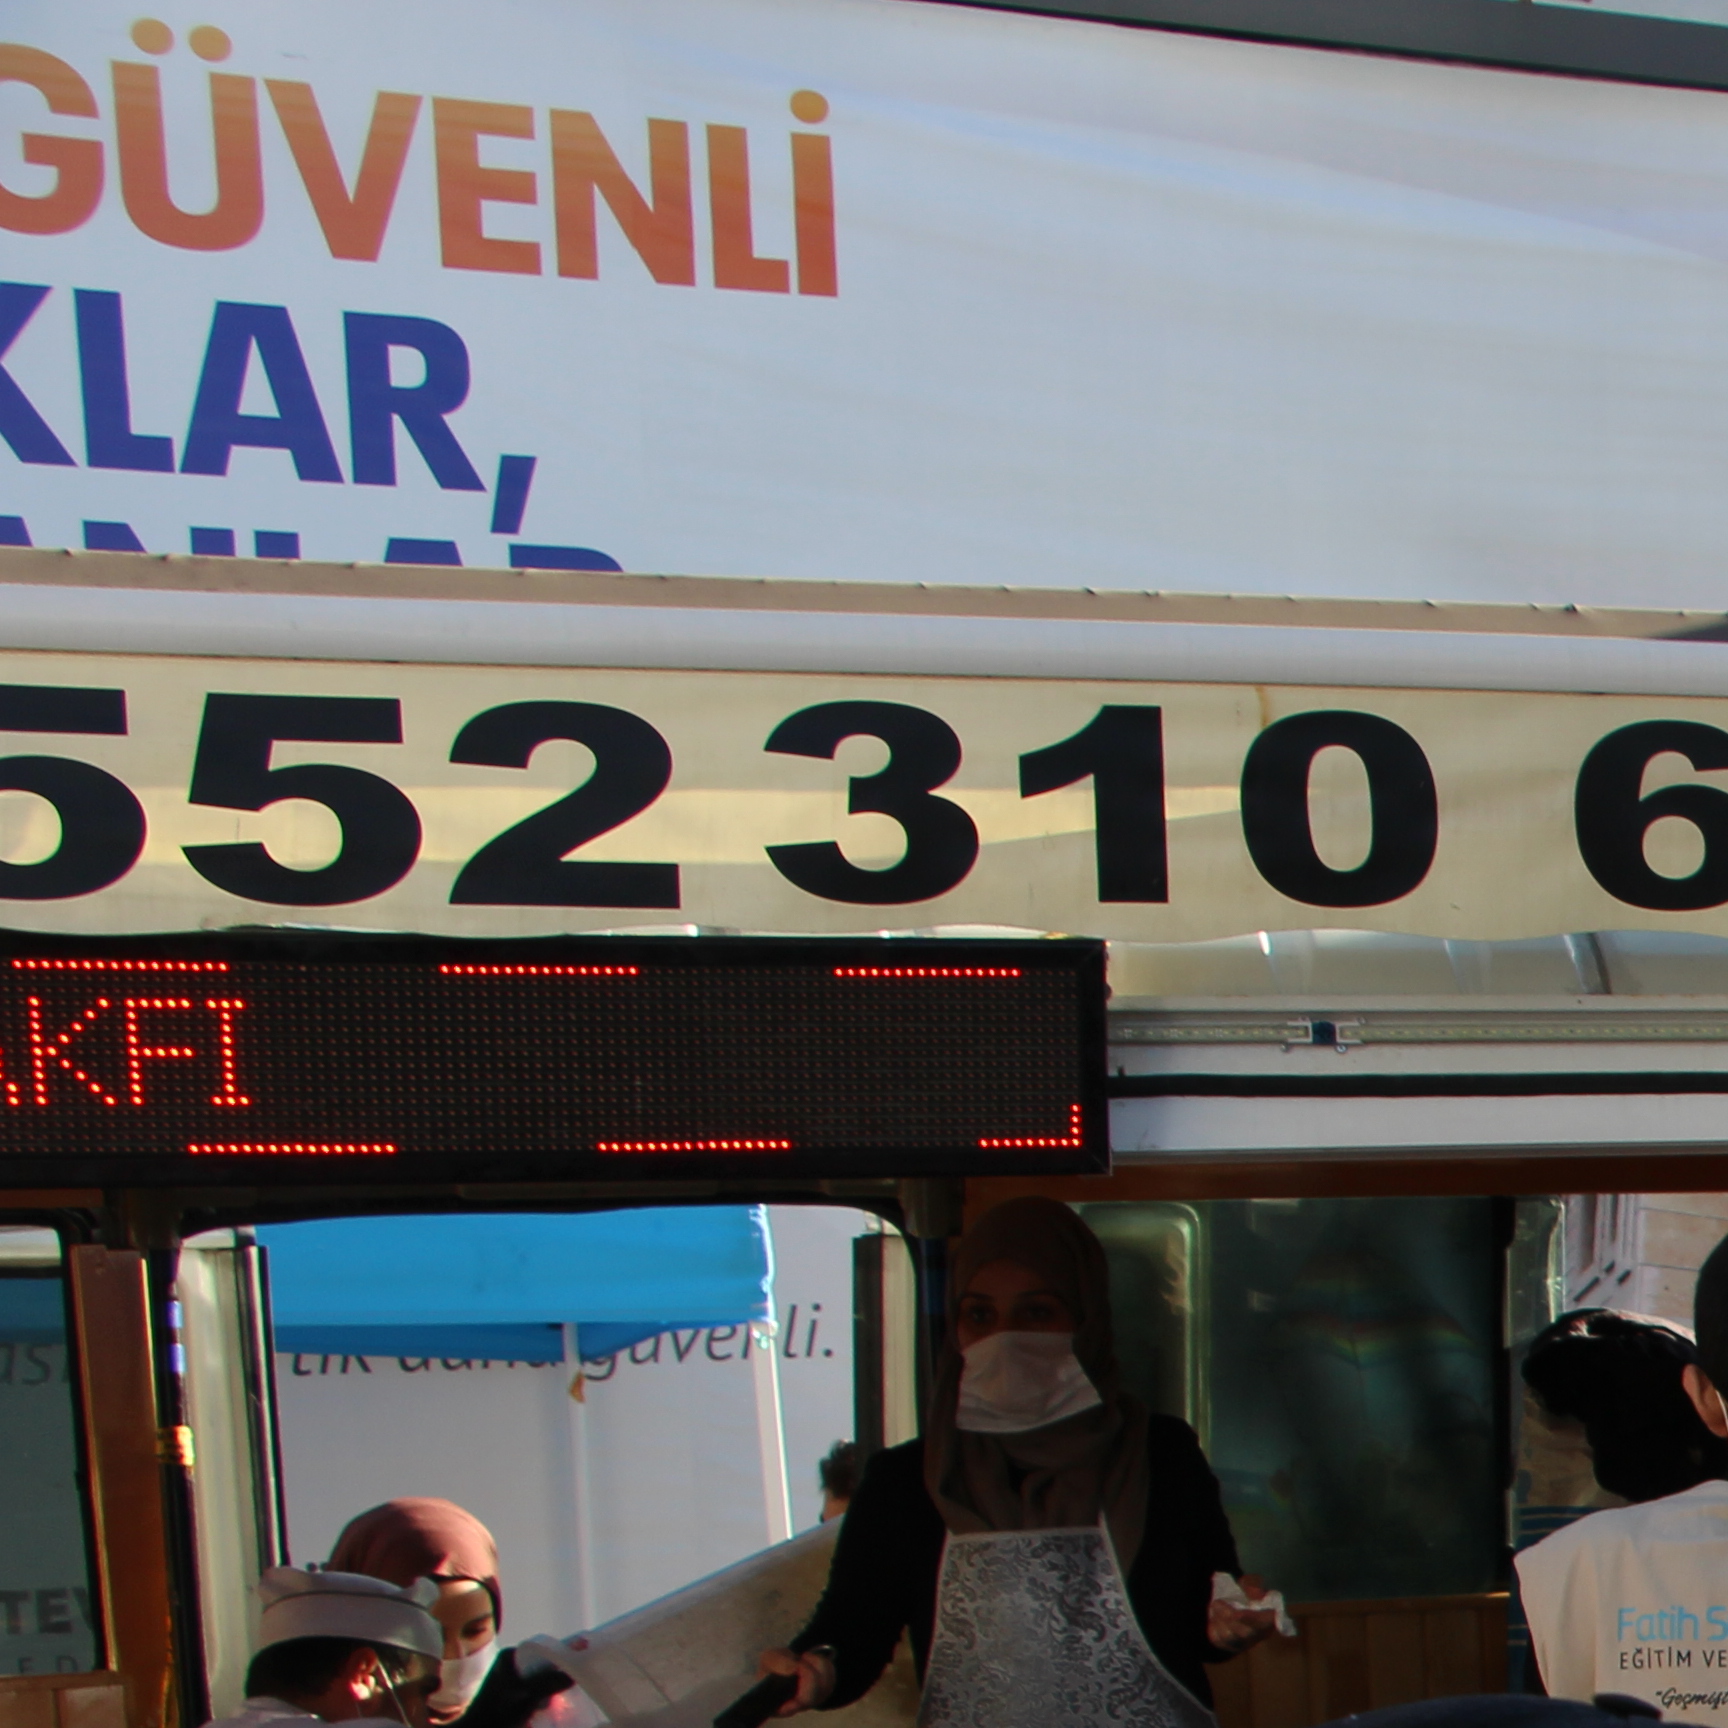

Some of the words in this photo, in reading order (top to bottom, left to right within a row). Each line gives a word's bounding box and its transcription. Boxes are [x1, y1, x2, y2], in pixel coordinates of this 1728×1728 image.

[0, 17, 839, 298] GÜVENLİ
[764, 699, 1440, 908] 310
[1617, 1605, 1699, 1642] Fatih
[1619, 1646, 1692, 1670] EĞİTİM
[1702, 1648, 1728, 1669] VE
